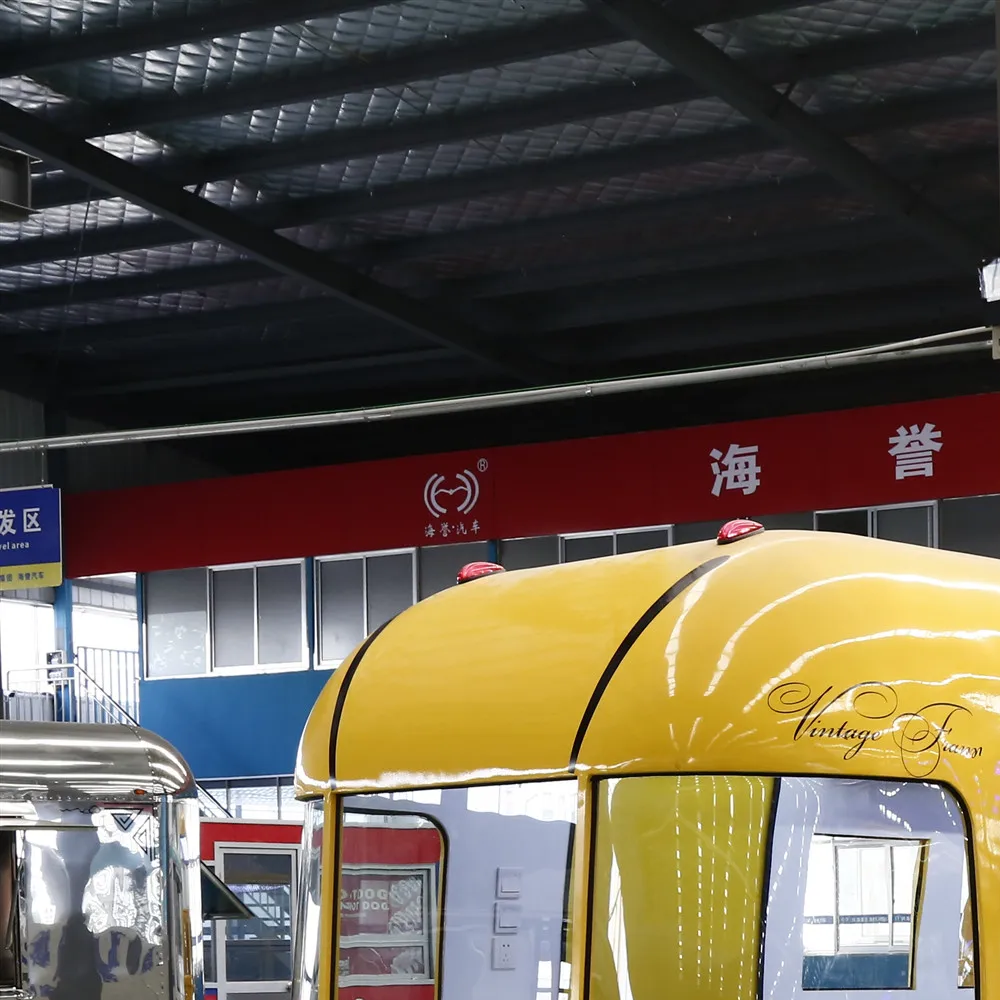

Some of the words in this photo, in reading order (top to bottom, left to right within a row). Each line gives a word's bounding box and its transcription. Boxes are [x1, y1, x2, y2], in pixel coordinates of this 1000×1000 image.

[0, 507, 41, 536] 发区
[11, 541, 30, 550] area
[767, 681, 898, 761] Vintage
